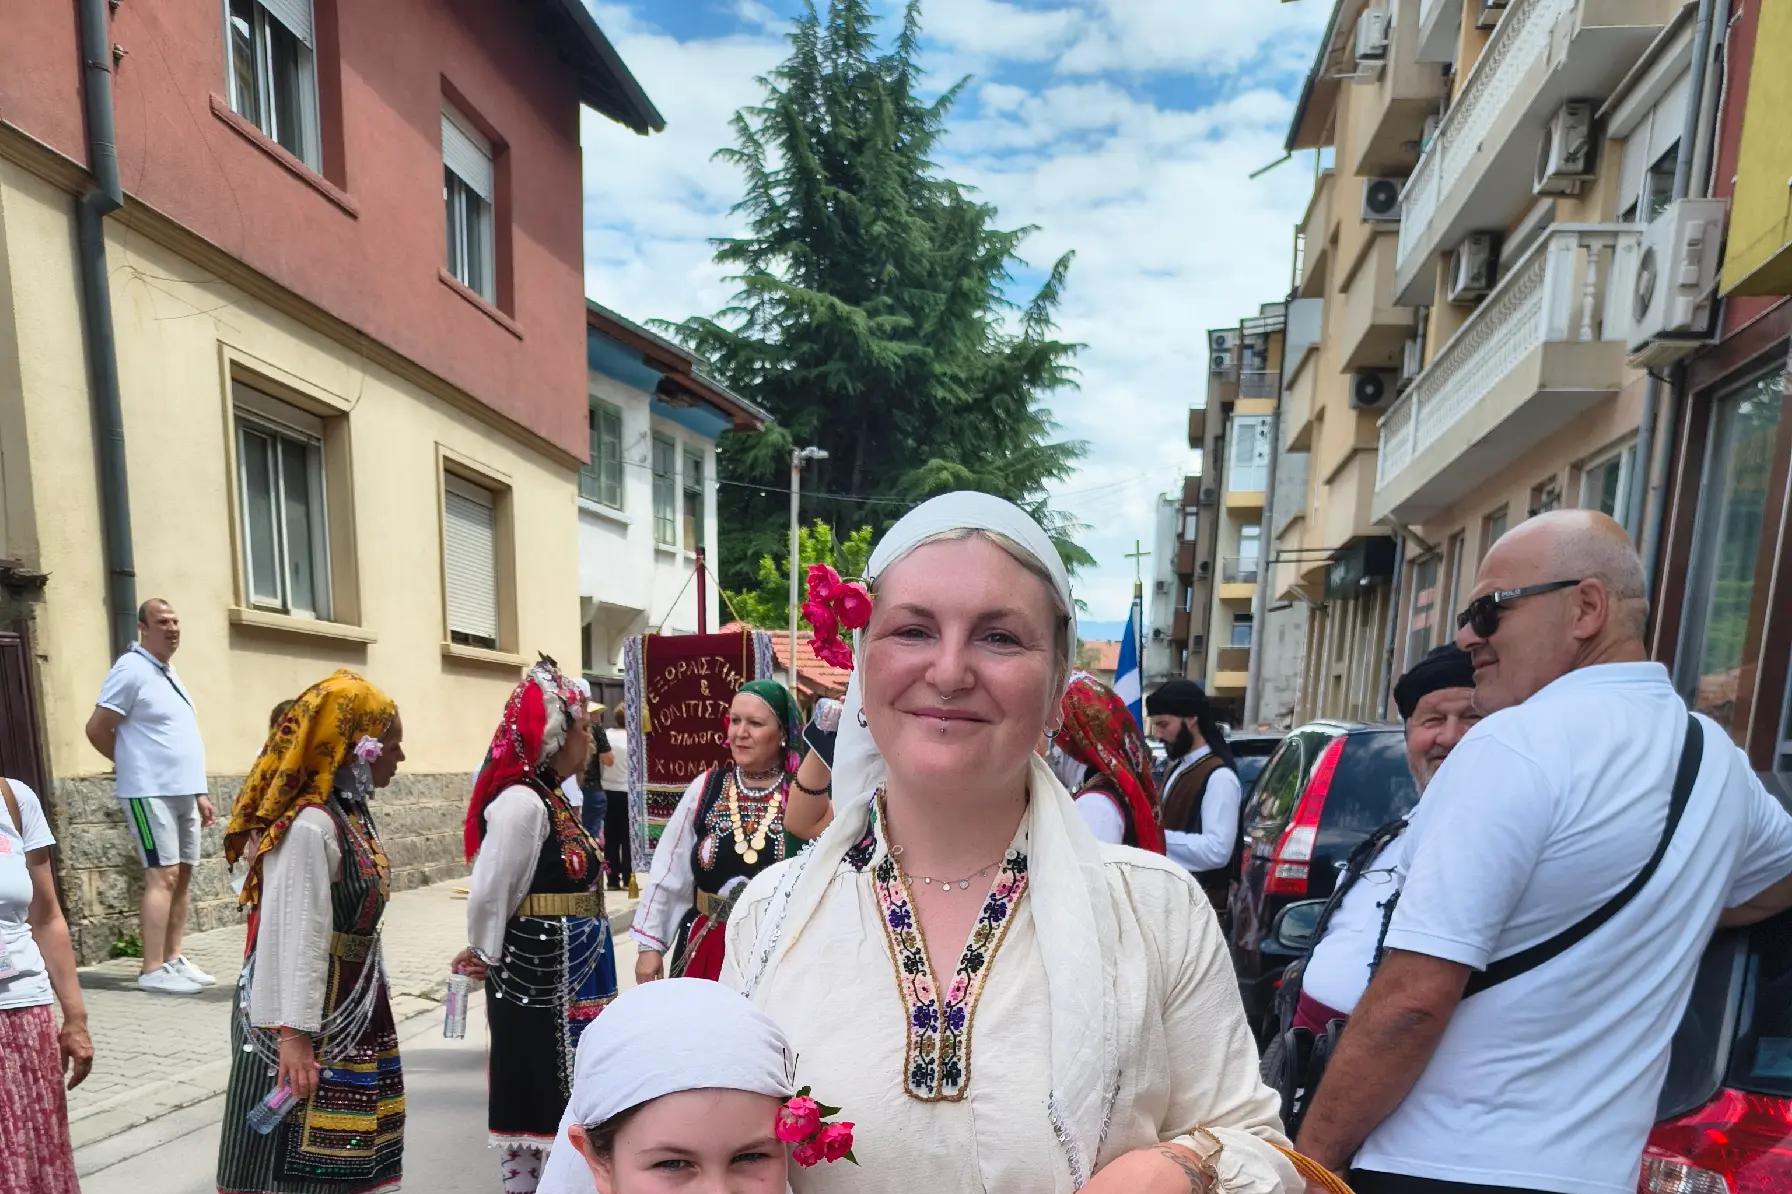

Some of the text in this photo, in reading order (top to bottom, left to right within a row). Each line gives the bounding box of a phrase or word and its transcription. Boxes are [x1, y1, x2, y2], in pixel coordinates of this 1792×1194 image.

[648, 656, 744, 703] ΕΞΩΡΑΙΣΤΙΚΟ
[700, 679, 711, 696] &
[670, 730, 724, 746] ΣΥΛΛΟΓΟ
